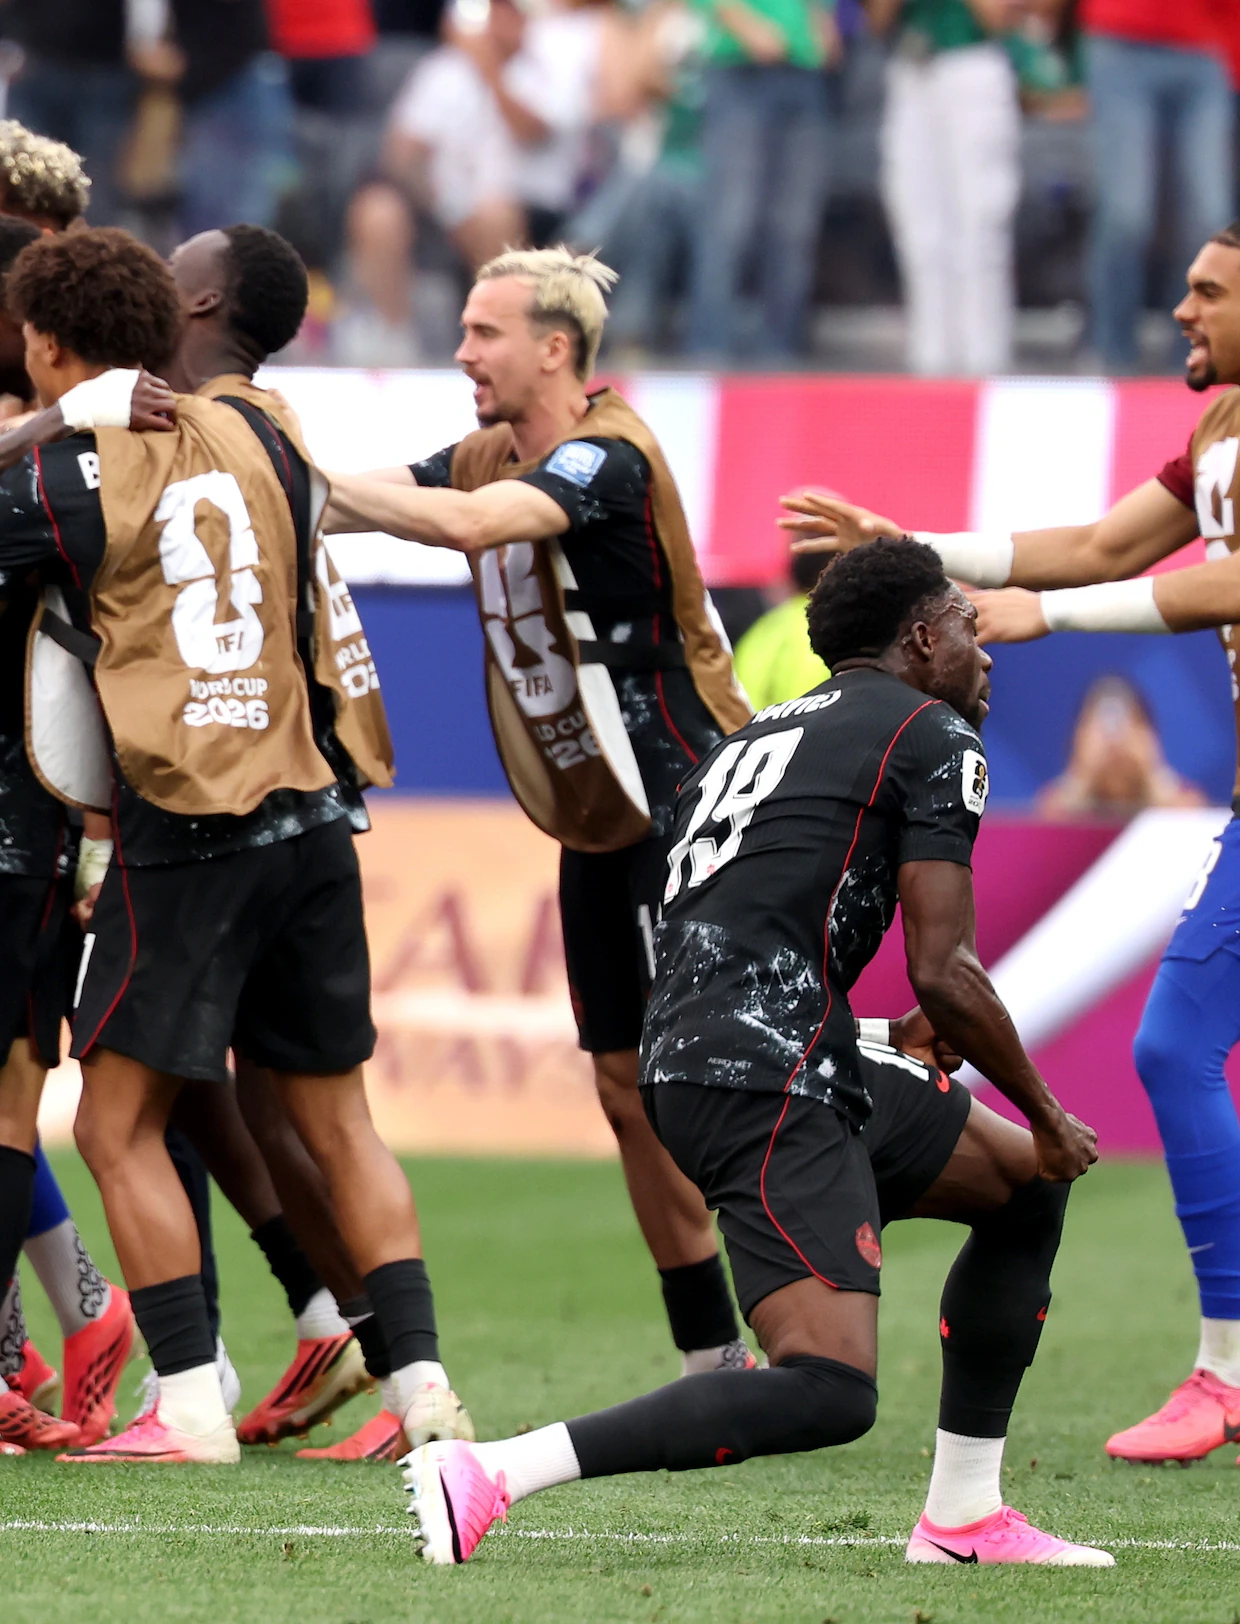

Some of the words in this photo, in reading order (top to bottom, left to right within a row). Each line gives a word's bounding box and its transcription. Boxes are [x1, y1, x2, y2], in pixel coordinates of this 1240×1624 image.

[232, 677, 268, 697] CUP
[183, 696, 270, 731] 2026
[663, 727, 805, 906] 19
